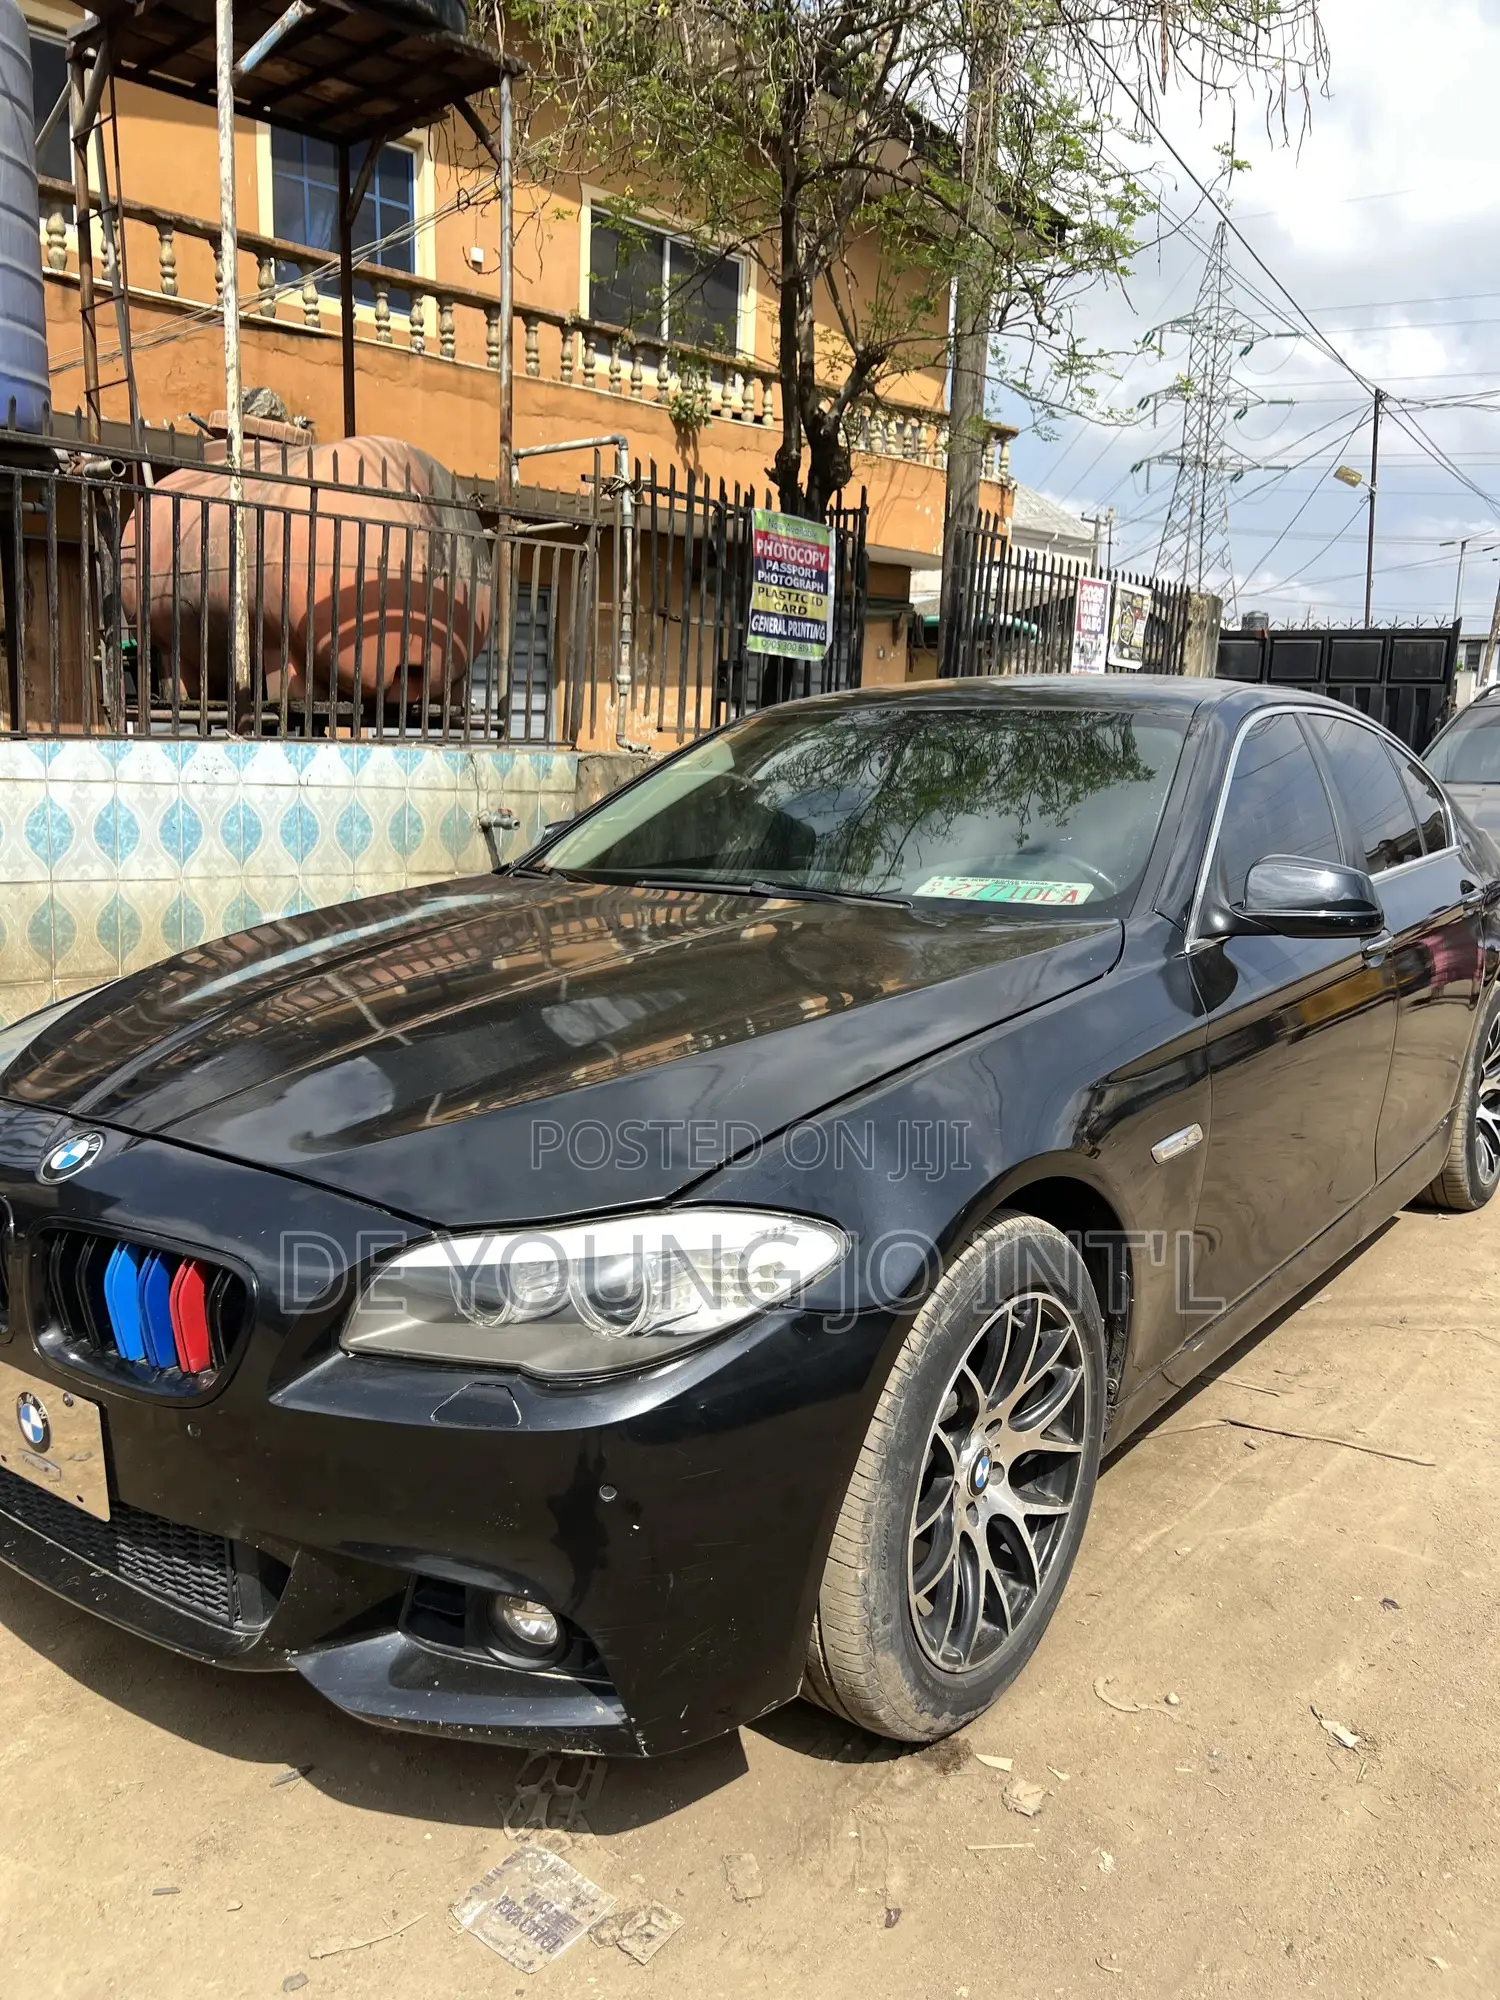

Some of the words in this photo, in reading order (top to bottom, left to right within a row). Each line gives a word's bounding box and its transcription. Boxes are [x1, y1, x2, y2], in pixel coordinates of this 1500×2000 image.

[756, 538, 826, 568] PHOTOCOPY
[766, 559, 817, 579] PASSPORT
[757, 570, 824, 593] PHOTOGRAPH
[757, 586, 808, 604] PLASTIC
[811, 596, 823, 607] ID
[773, 602, 808, 616] CARD
[751, 614, 787, 636] GENERAL
[787, 620, 826, 640] PRINTING
